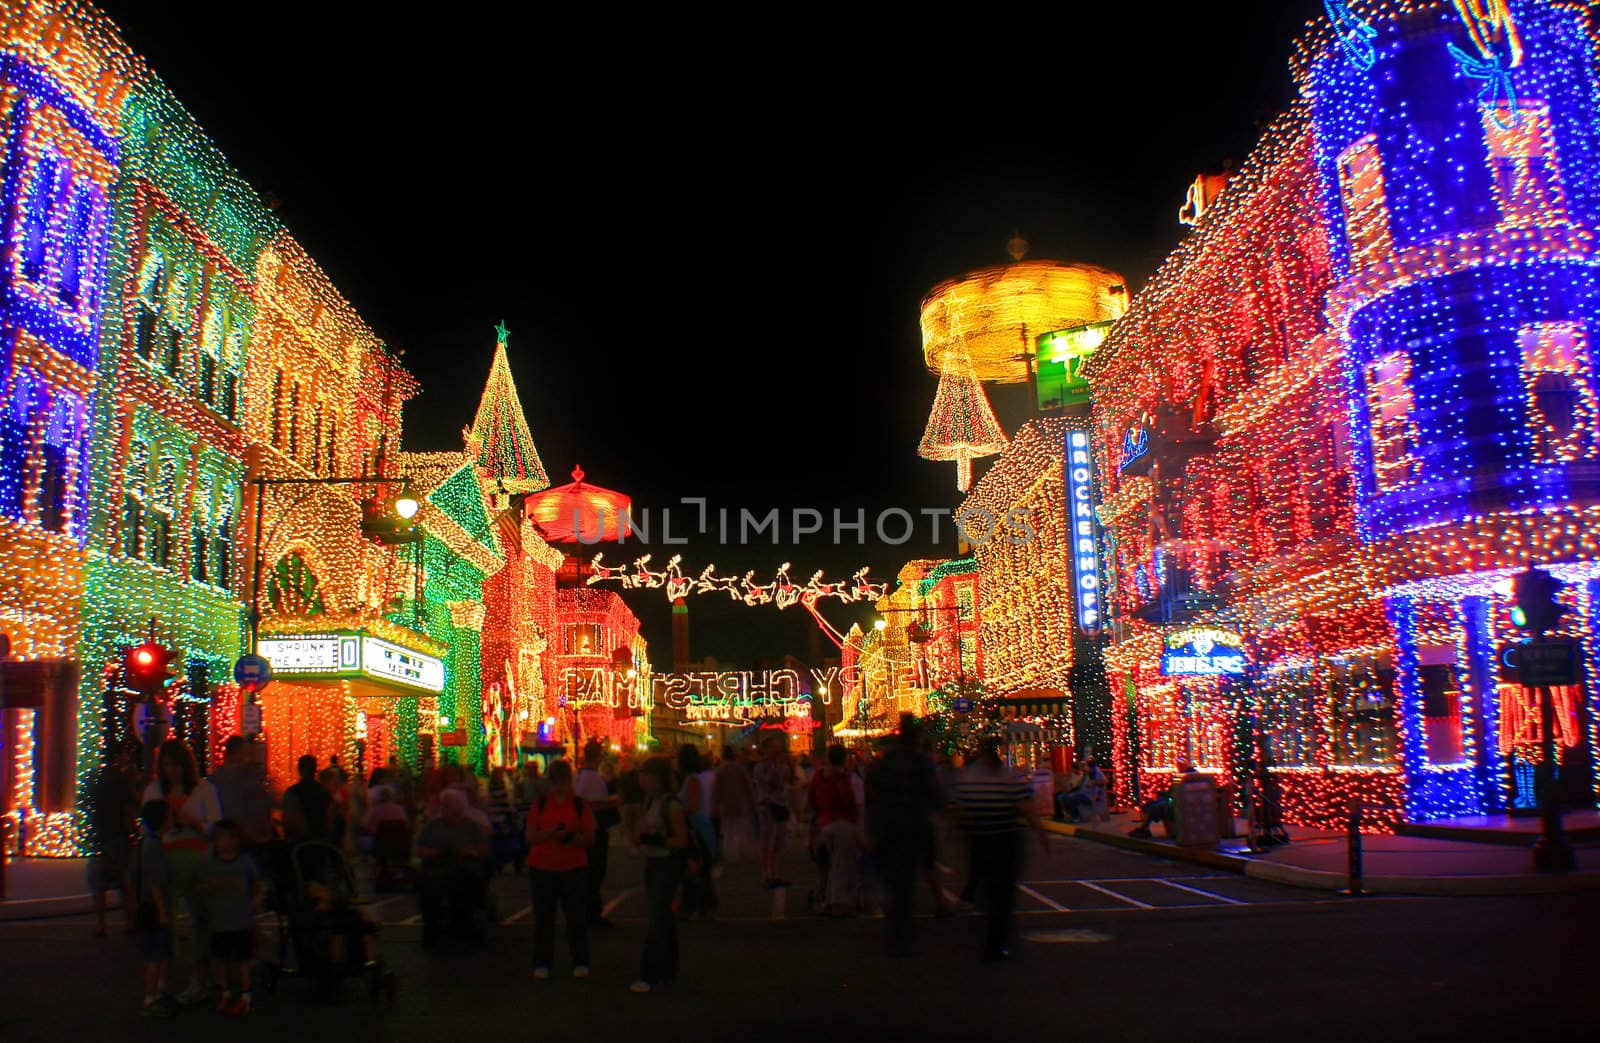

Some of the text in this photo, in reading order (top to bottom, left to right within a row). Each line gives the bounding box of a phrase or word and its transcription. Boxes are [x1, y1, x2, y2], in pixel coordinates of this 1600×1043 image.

[1072, 433, 1098, 625] BROCKERHOFF
[277, 642, 324, 653] SHRUNK
[295, 655, 325, 666] KDS
